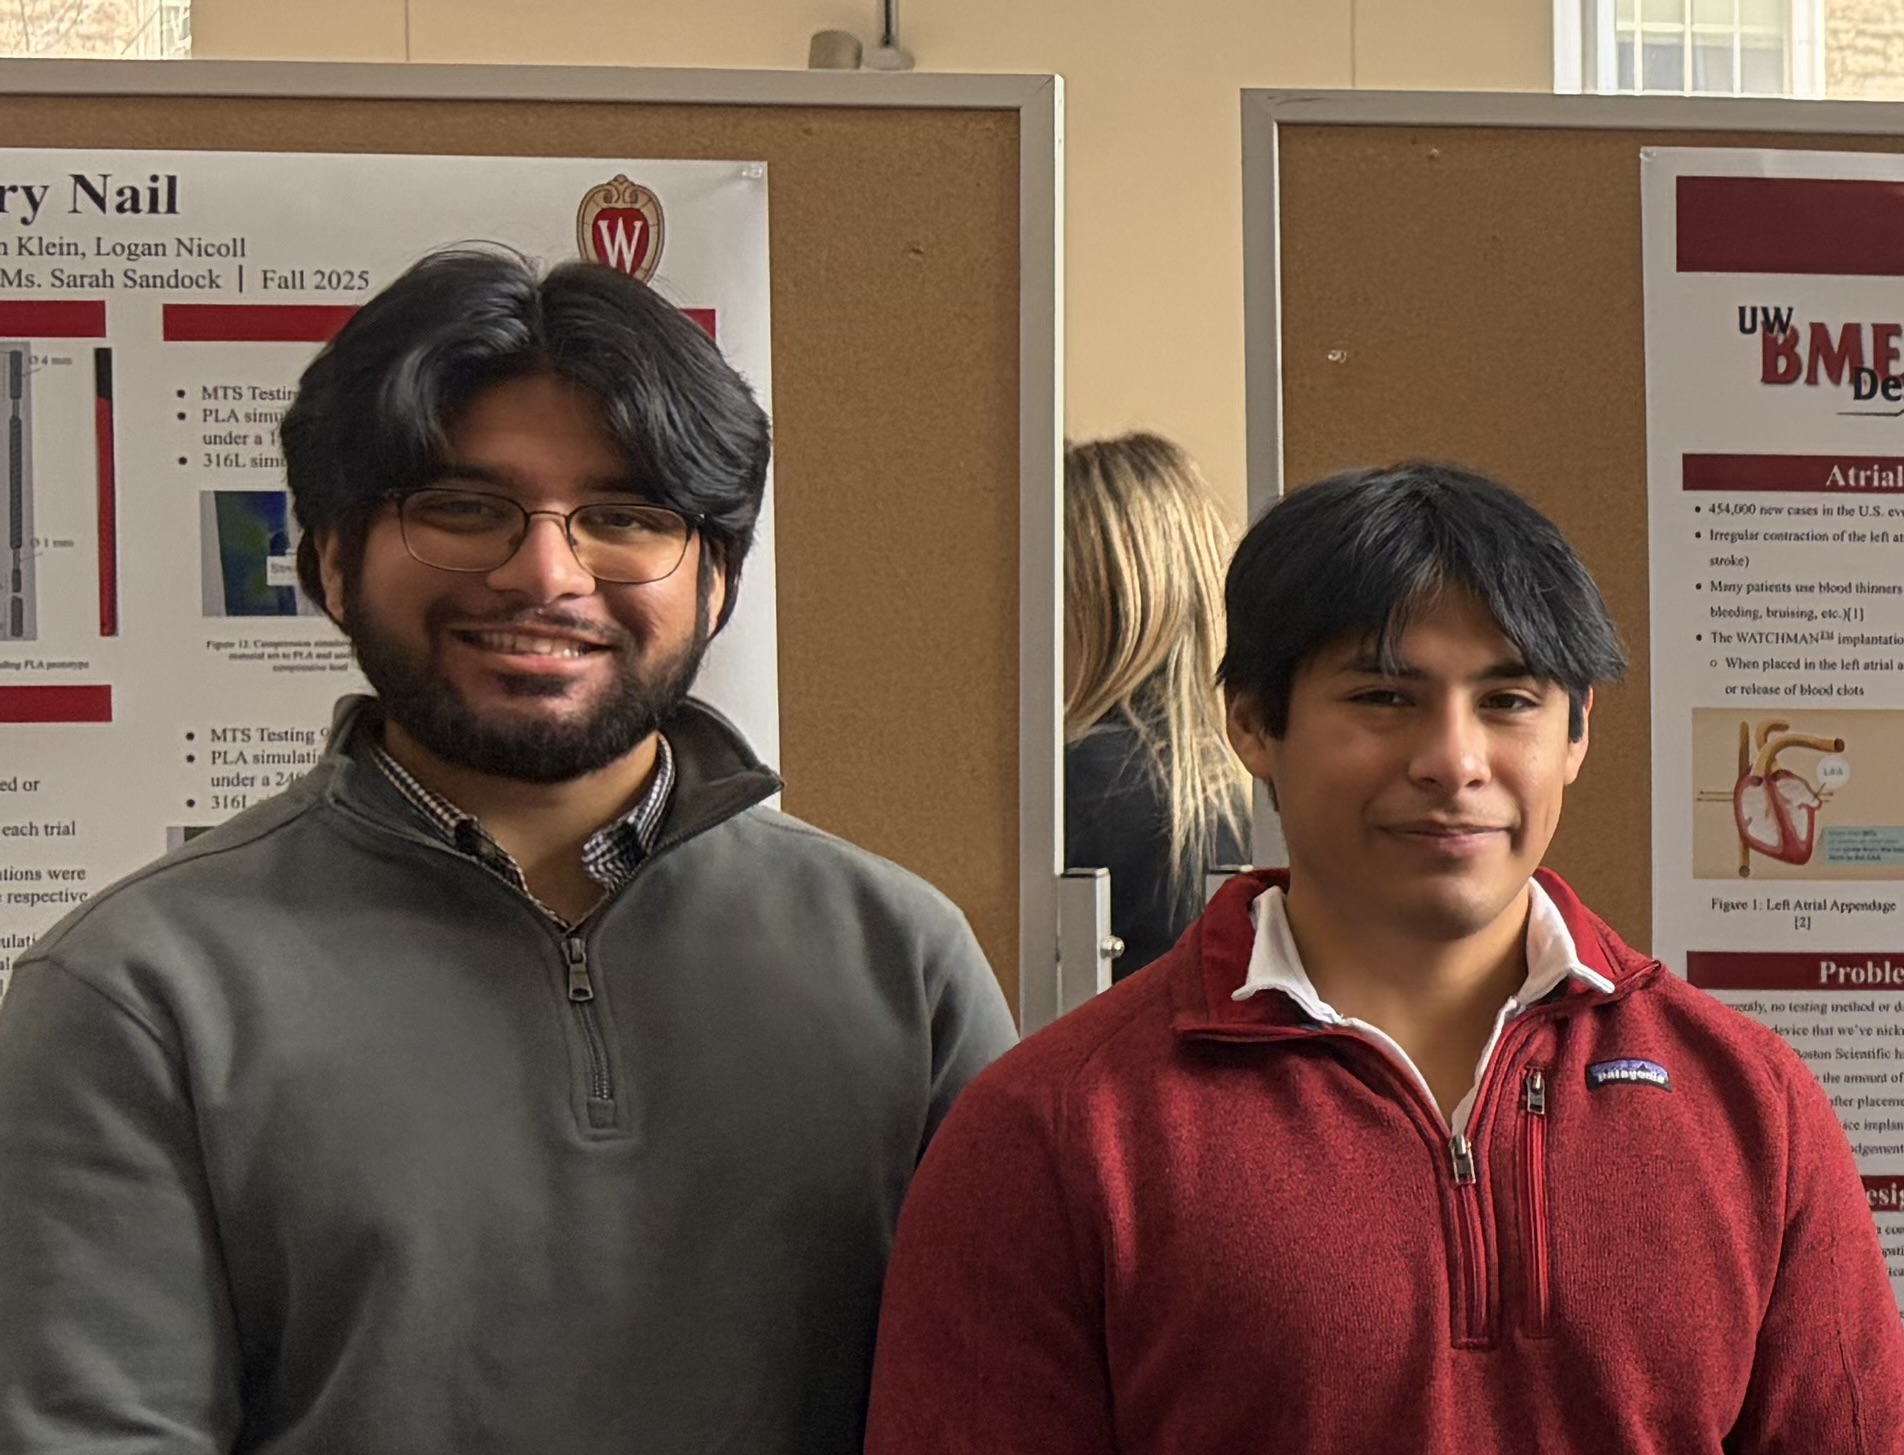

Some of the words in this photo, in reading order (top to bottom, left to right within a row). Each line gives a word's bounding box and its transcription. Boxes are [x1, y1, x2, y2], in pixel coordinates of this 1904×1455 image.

[67, 173, 180, 215] Nail
[16, 235, 87, 260] Klein,
[94, 236, 168, 261] Logan
[174, 236, 246, 258] Nicoll
[0, 268, 42, 289] Ms.
[50, 268, 115, 289] Sarah
[122, 268, 222, 290] Sandock
[261, 269, 305, 290] Fall
[313, 269, 370, 291] 2025
[1737, 305, 1794, 336] UW
[202, 385, 244, 401] MTS
[247, 384, 295, 402] Testin
[202, 407, 240, 424] PLA
[202, 430, 250, 446] under
[253, 434, 263, 446] a
[203, 452, 247, 468] 316L
[1825, 465, 1904, 491] Atrial
[1759, 506, 1784, 516] new
[1786, 506, 1819, 516] cases
[1822, 503, 1834, 517] in
[1836, 504, 1856, 518] the
[210, 727, 252, 744] MTS
[256, 727, 316, 746] Testing
[211, 750, 248, 766] PLA
[252, 750, 318, 766] simulati
[22, 780, 41, 792] or
[210, 771, 256, 788] under
[261, 775, 271, 787] a
[210, 795, 247, 811] 316
[1, 821, 40, 838] each
[43, 820, 76, 837] trial
[46, 868, 86, 881] were
[1711, 897, 1749, 914] Figure
[1766, 898, 1791, 912] Left
[1793, 898, 1828, 912] Atrial
[1829, 899, 1897, 914] Appendage
[1596, 1068, 1667, 1085] patagonia
